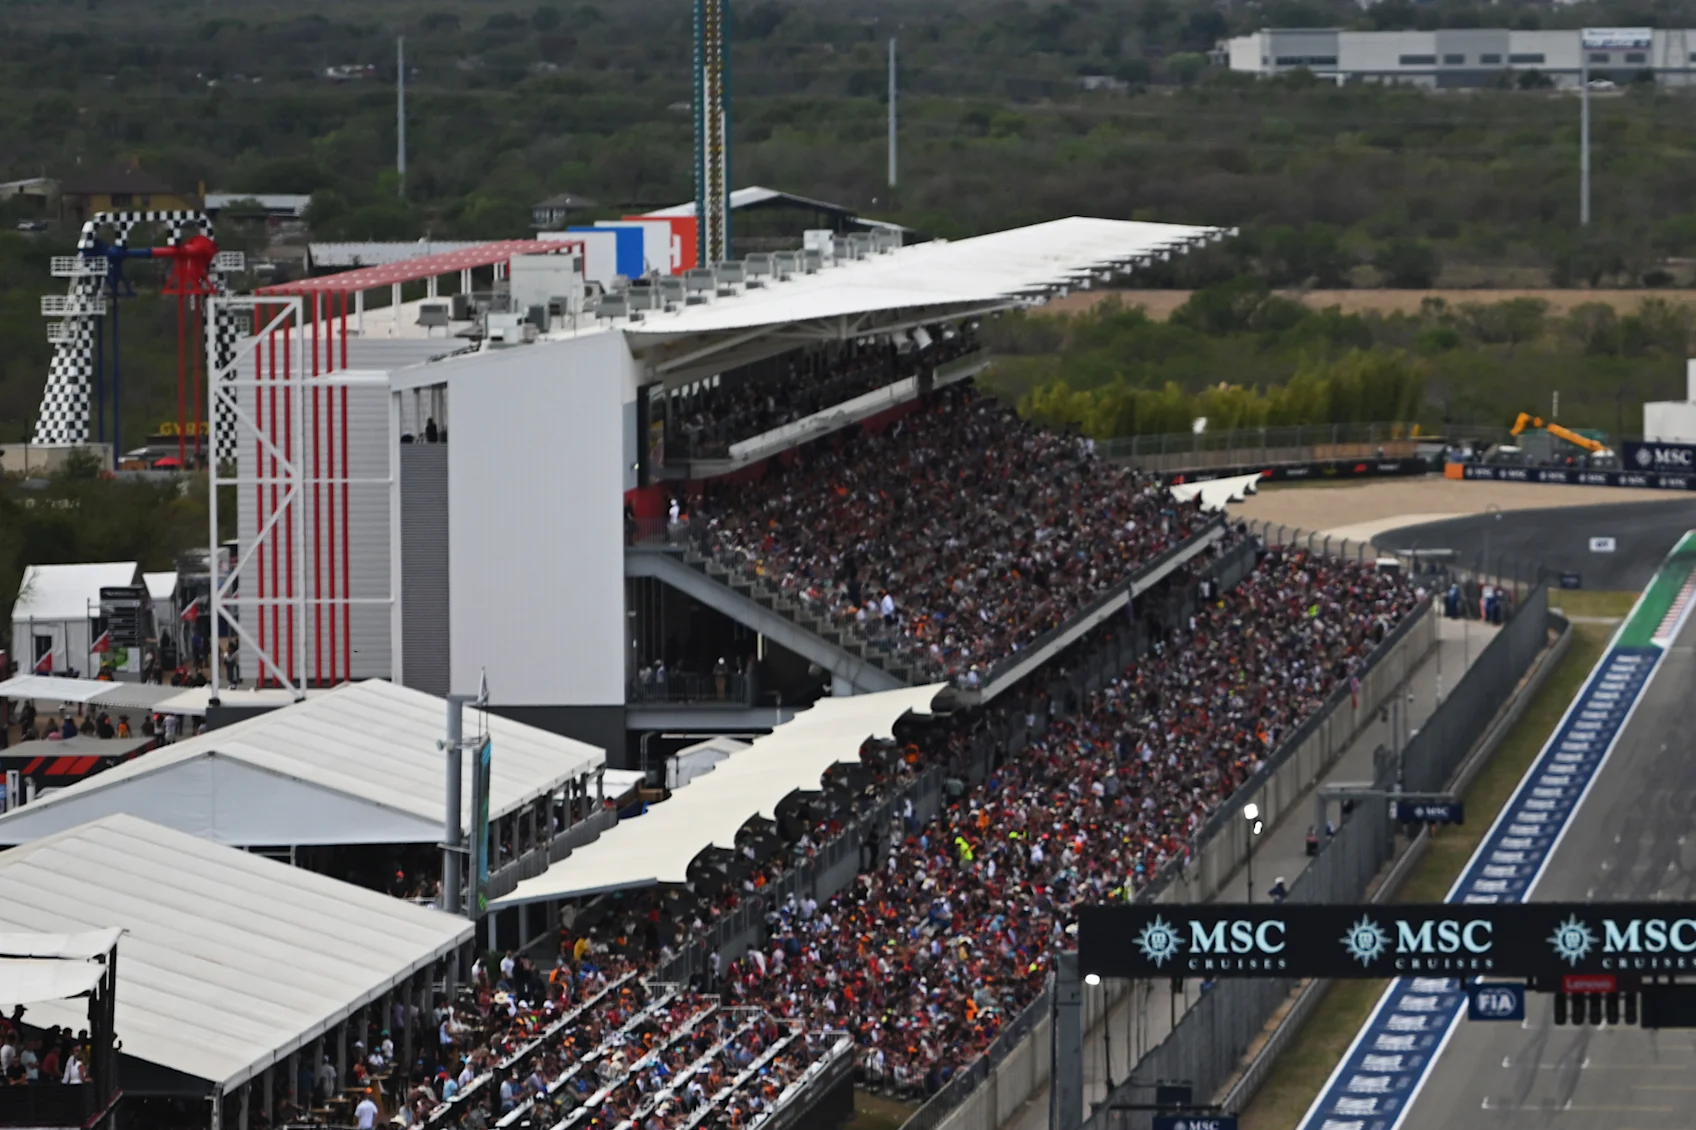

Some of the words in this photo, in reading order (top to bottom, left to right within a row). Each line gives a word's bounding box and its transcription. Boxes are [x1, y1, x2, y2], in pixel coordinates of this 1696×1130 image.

[1654, 449, 1693, 466] MSC
[1189, 919, 1286, 954] MSC
[1395, 919, 1492, 953] MSC
[1189, 958, 1287, 970] CRUISES
[1395, 957, 1493, 970] CRUISES
[1478, 992, 1512, 1011] FIA
